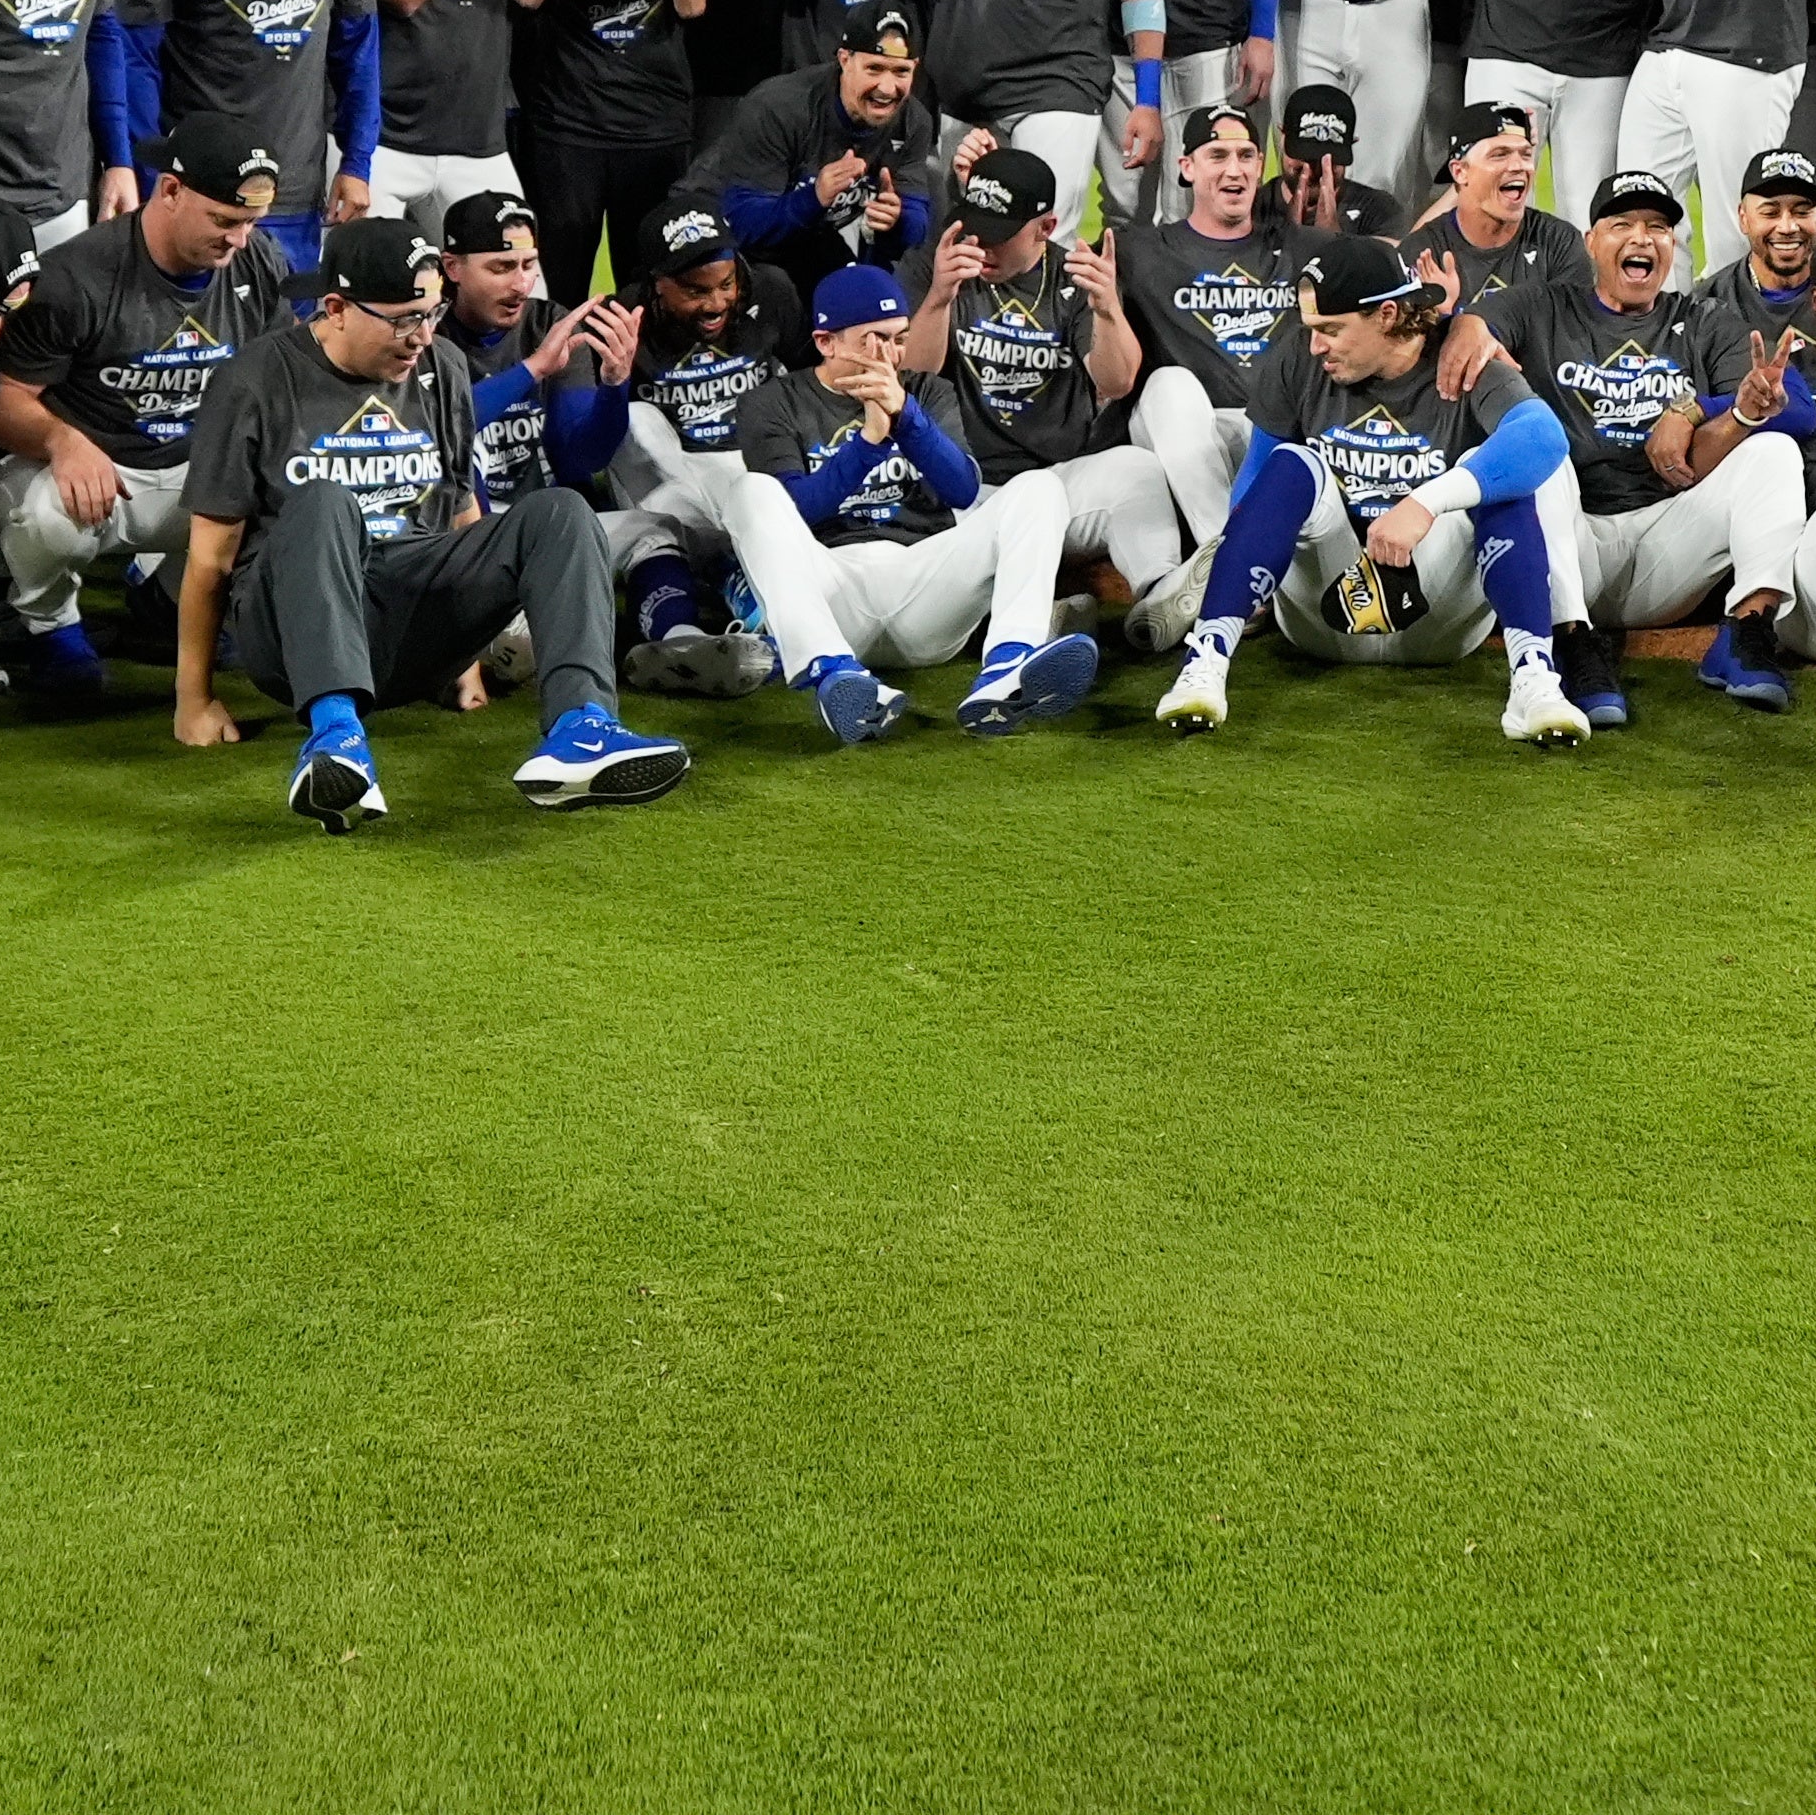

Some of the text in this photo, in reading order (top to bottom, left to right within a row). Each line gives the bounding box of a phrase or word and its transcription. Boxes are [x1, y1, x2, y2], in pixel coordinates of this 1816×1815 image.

[1173, 285, 1297, 311] CHAMPIONS
[1212, 310, 1275, 340] Dodgers
[956, 330, 1072, 370] CHAMPIONS
[99, 365, 218, 391] CHAMPI
[981, 364, 1043, 394] Dodgers
[1556, 360, 1697, 400] CHAMPIONS
[1593, 398, 1664, 427] Dodgers
[323, 435, 381, 448] NATIONAL
[481, 413, 546, 445] MPION
[285, 450, 442, 485] CHAMPIONS
[1306, 436, 1447, 479] CHAMPIONS
[1360, 505, 1391, 518] 202
